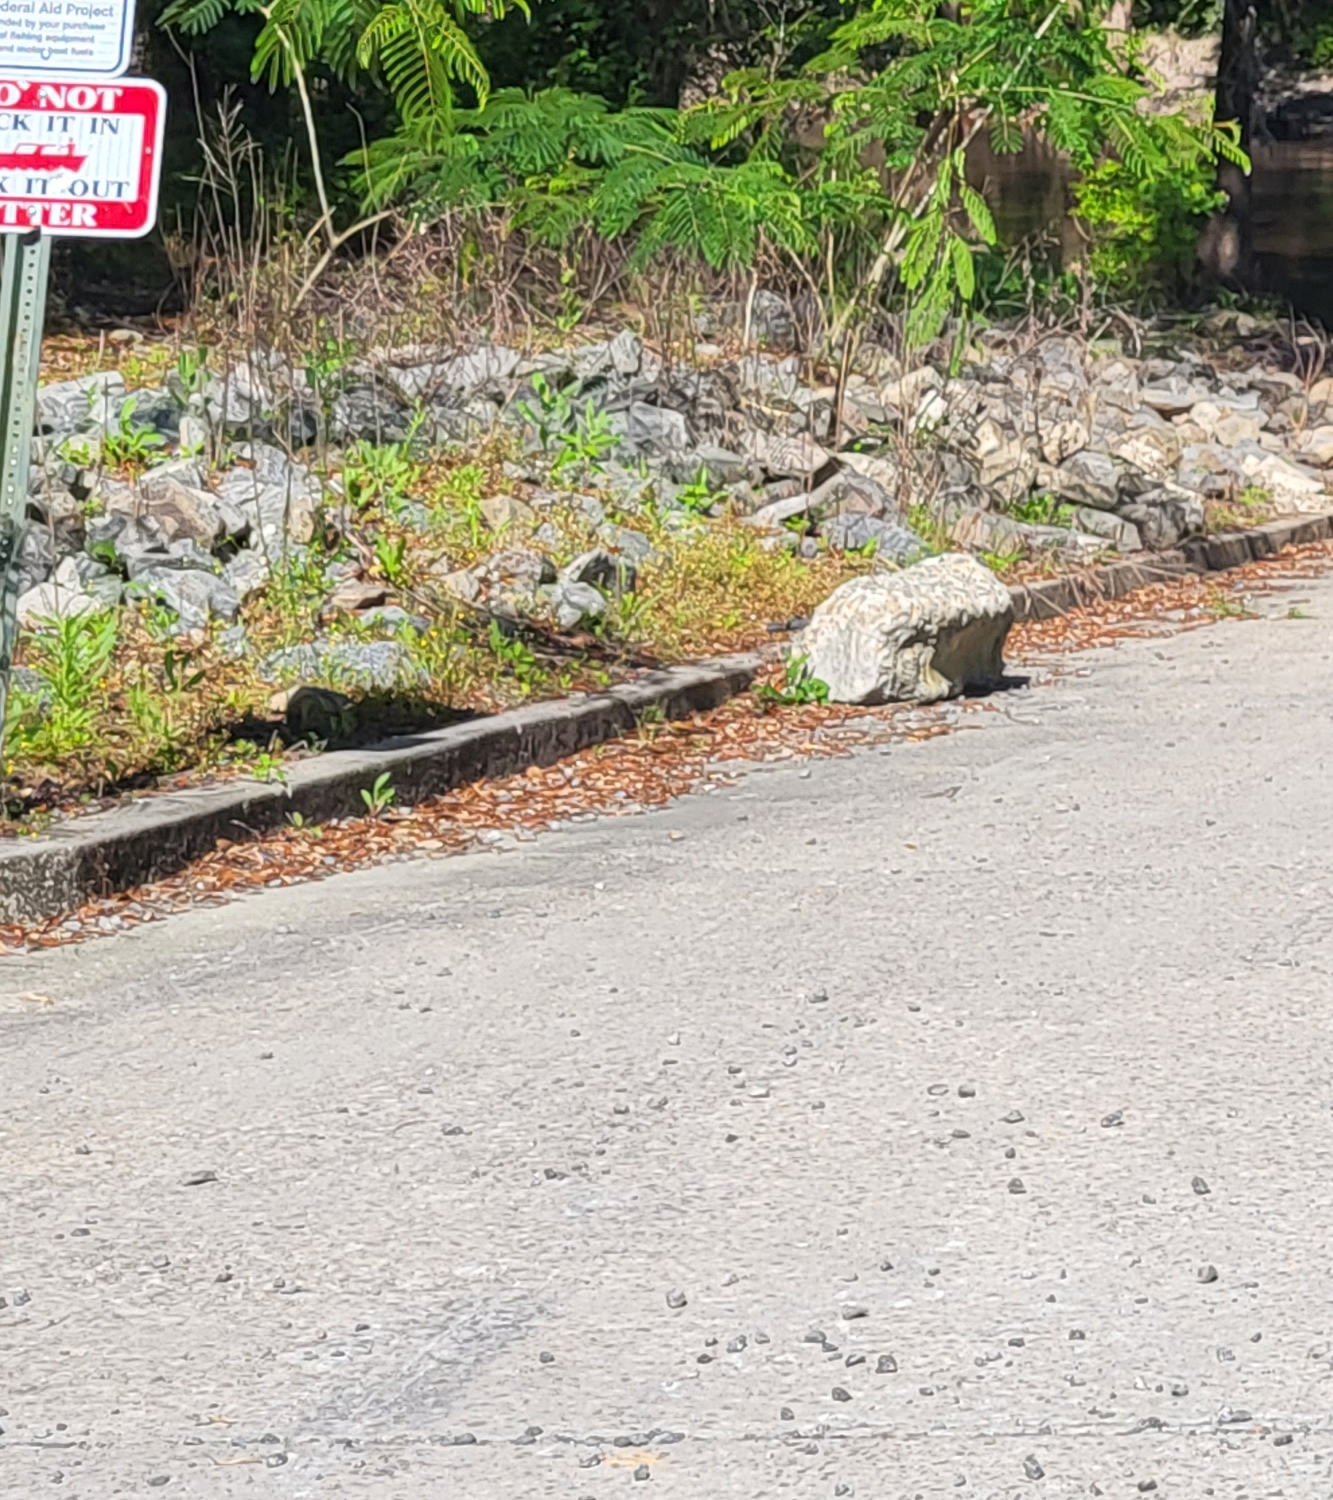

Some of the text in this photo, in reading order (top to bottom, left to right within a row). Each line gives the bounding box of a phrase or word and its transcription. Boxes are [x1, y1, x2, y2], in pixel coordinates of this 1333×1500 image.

[0, 0, 115, 20] deral Aid Project
[0, 17, 106, 31] nded by your purchase
[0, 82, 124, 112] O NOT
[0, 113, 121, 136] CK IT IN
[26, 178, 54, 196] IT
[68, 179, 130, 199] OUT
[0, 200, 98, 228] TTER
